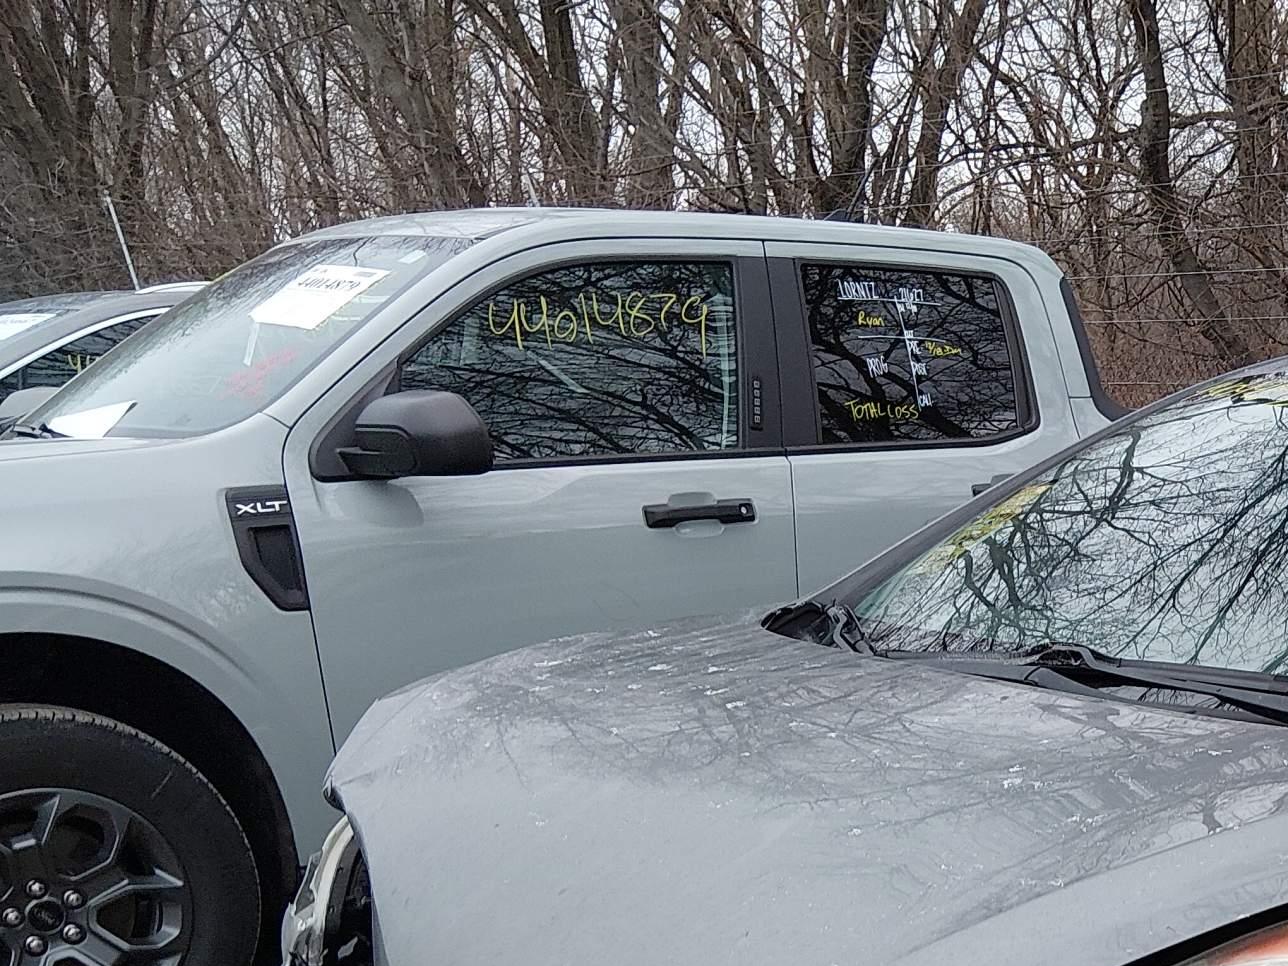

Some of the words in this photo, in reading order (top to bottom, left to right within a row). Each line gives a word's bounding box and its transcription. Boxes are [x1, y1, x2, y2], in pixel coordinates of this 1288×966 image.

[488, 292, 709, 358] 44014879
[858, 311, 885, 328] Ryan
[866, 355, 889, 378] PROG
[845, 400, 886, 422] TOTAL
[887, 404, 919, 419] LOSS
[235, 500, 287, 516] XLT
